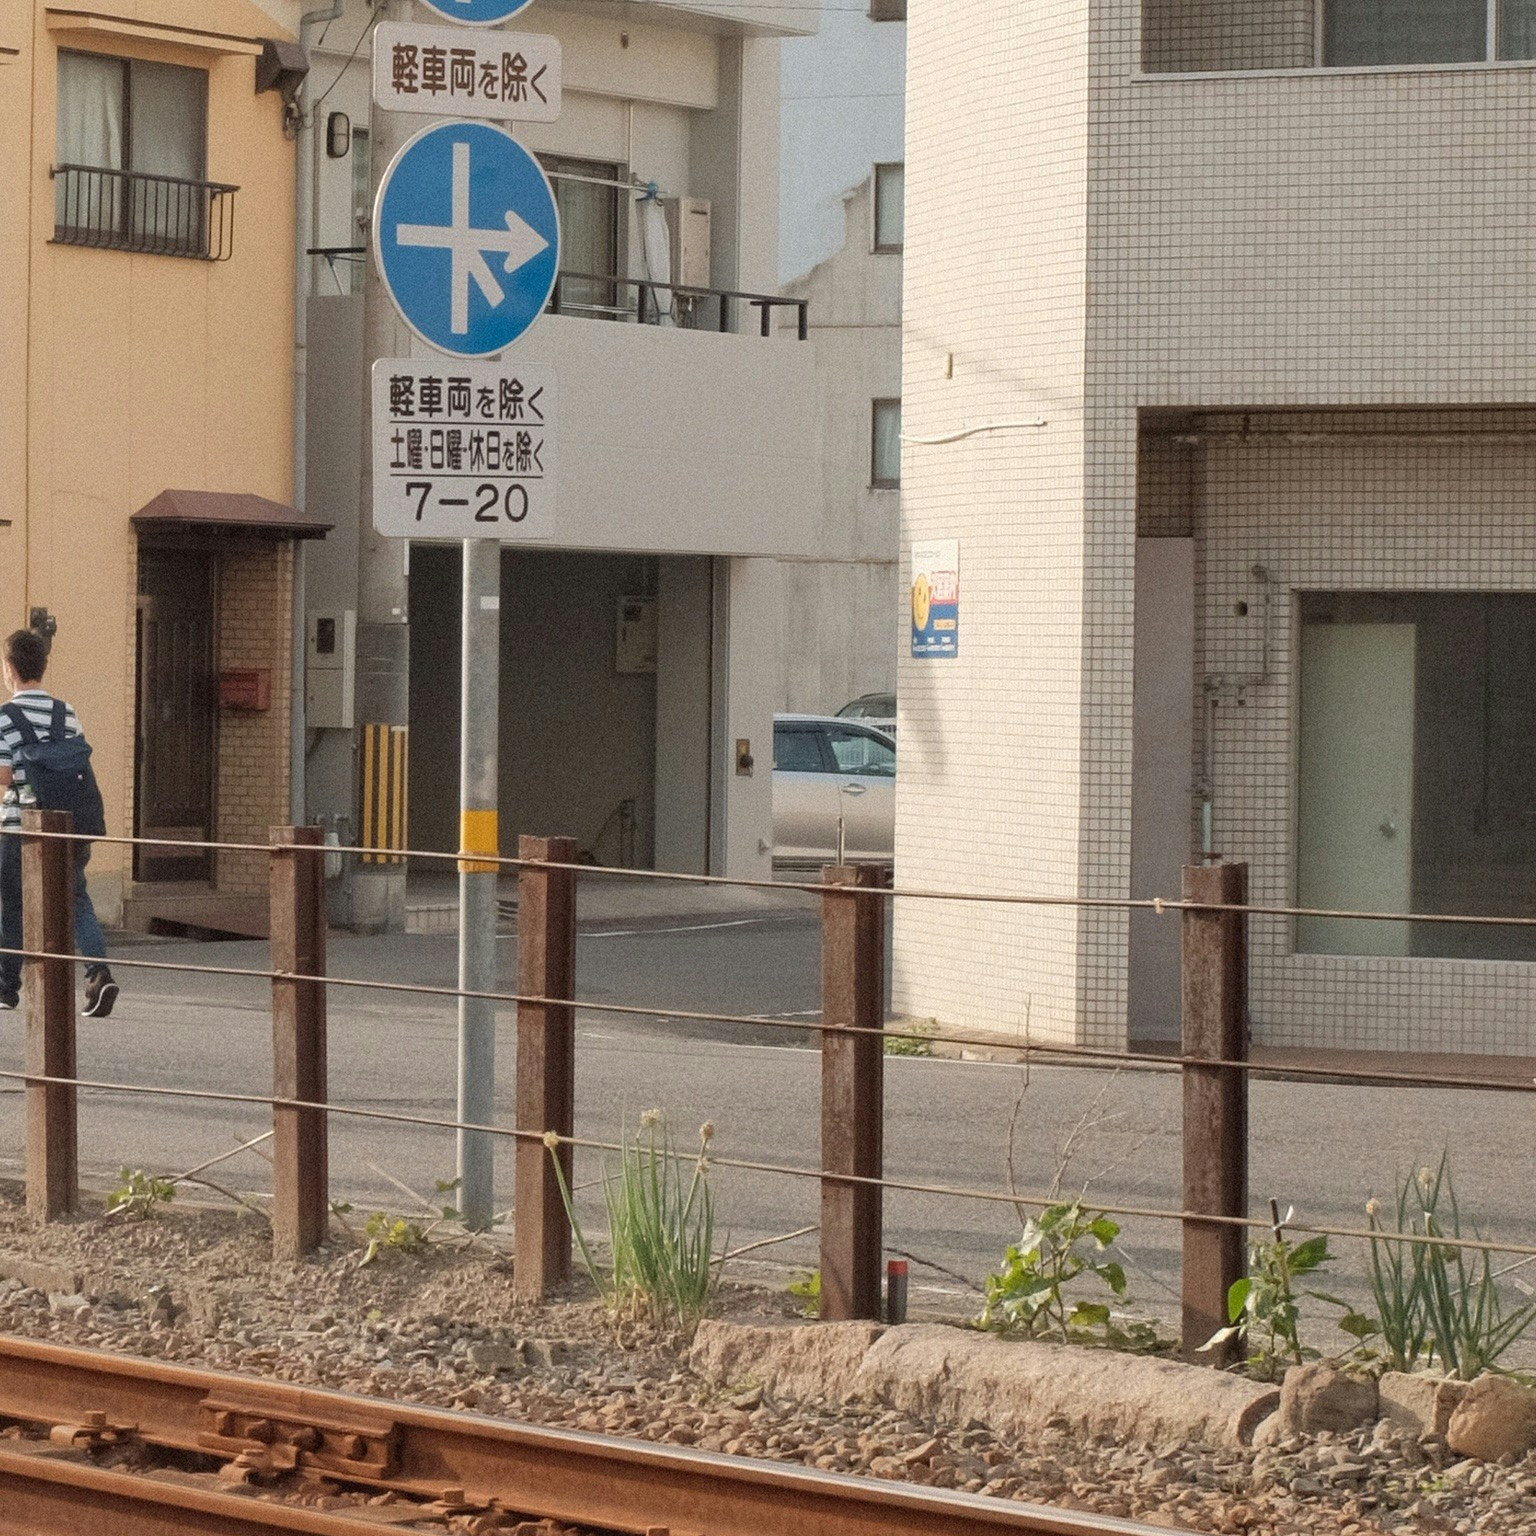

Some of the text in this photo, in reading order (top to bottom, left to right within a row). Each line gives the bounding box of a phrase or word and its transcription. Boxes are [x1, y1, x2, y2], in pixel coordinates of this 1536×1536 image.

[390, 42, 548, 105] 軽車両を除く
[389, 374, 544, 423] 軽車両を除く
[404, 481, 529, 524] 7-20
